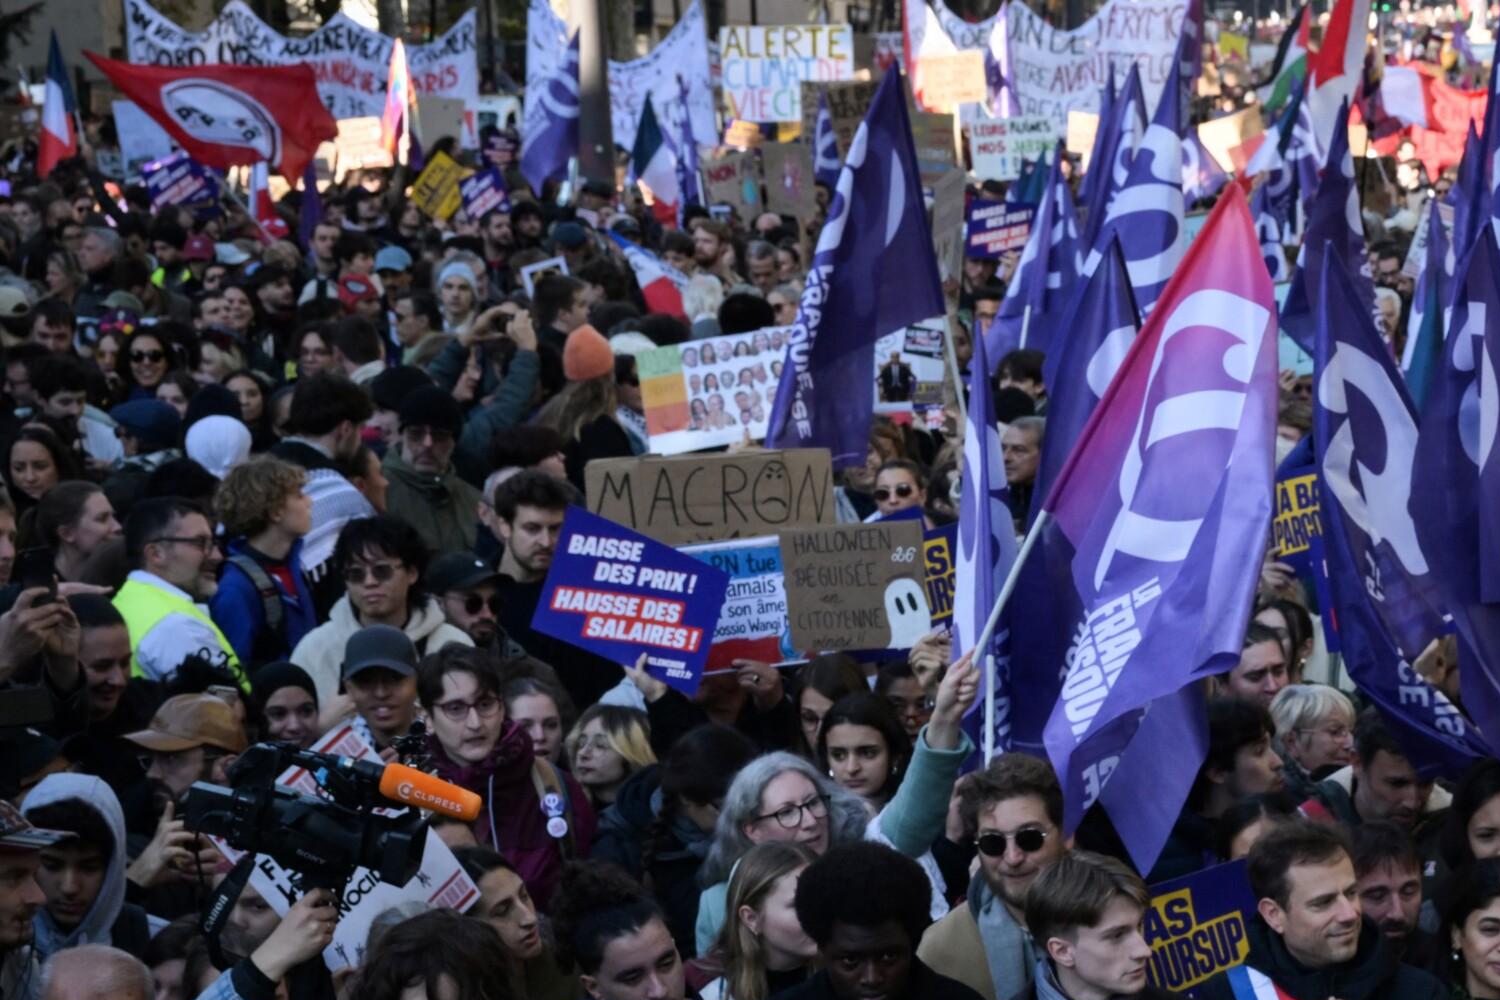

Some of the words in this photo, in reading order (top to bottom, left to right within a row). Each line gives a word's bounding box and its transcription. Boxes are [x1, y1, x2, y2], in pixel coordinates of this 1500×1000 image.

[722, 26, 847, 59] ALERTE
[725, 56, 816, 89] CLIMAT
[601, 459, 831, 529] MACRON
[567, 533, 645, 562] BAISSE
[793, 528, 892, 555] HALLOWEEN
[593, 561, 637, 586] DES
[637, 567, 688, 593] PRIX
[745, 555, 777, 573] tue
[794, 561, 878, 588] DÉGUISÉE
[727, 576, 777, 598] amais
[553, 588, 640, 617] HAUSSE
[641, 601, 682, 624] DES
[727, 603, 751, 619] son
[756, 600, 785, 617] âme
[797, 607, 886, 632] CITOYENNE
[586, 616, 687, 649] SALAIRES
[1144, 892, 1194, 946] AS
